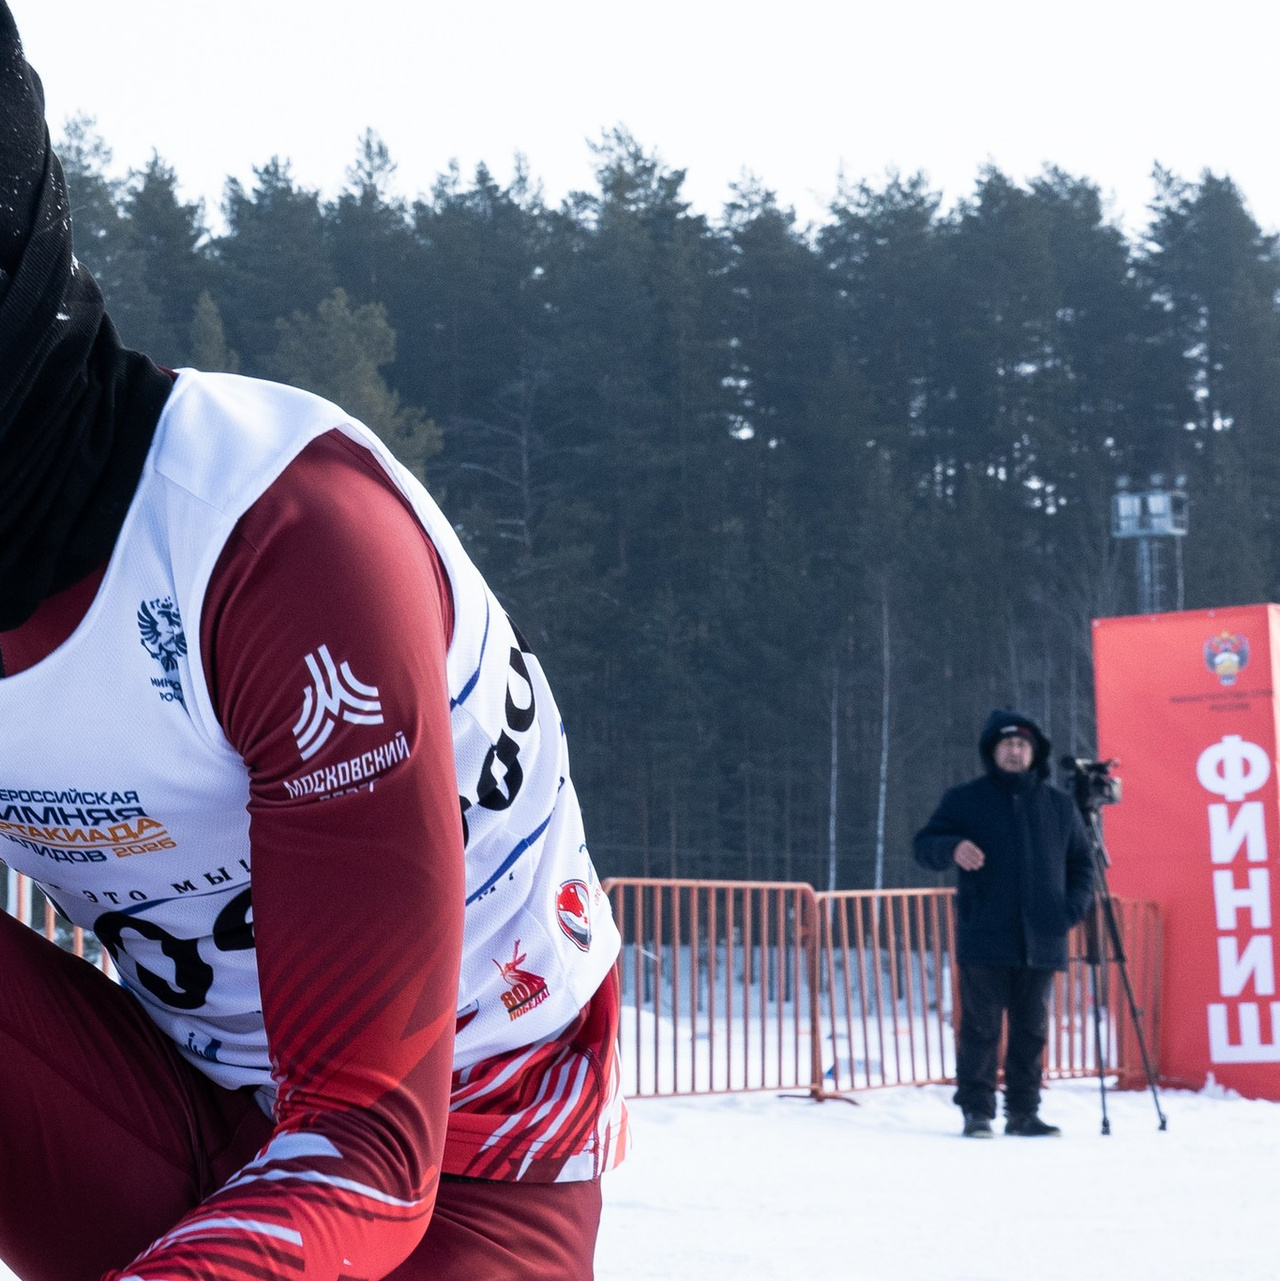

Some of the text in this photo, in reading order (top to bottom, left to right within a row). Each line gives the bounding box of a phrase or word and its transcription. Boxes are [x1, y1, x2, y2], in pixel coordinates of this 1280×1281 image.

[283, 730, 411, 799] МОСКОВСКИЙ
[82, 889, 148, 906] ЭТО
[1196, 734, 1280, 1065] ФИНИШ
